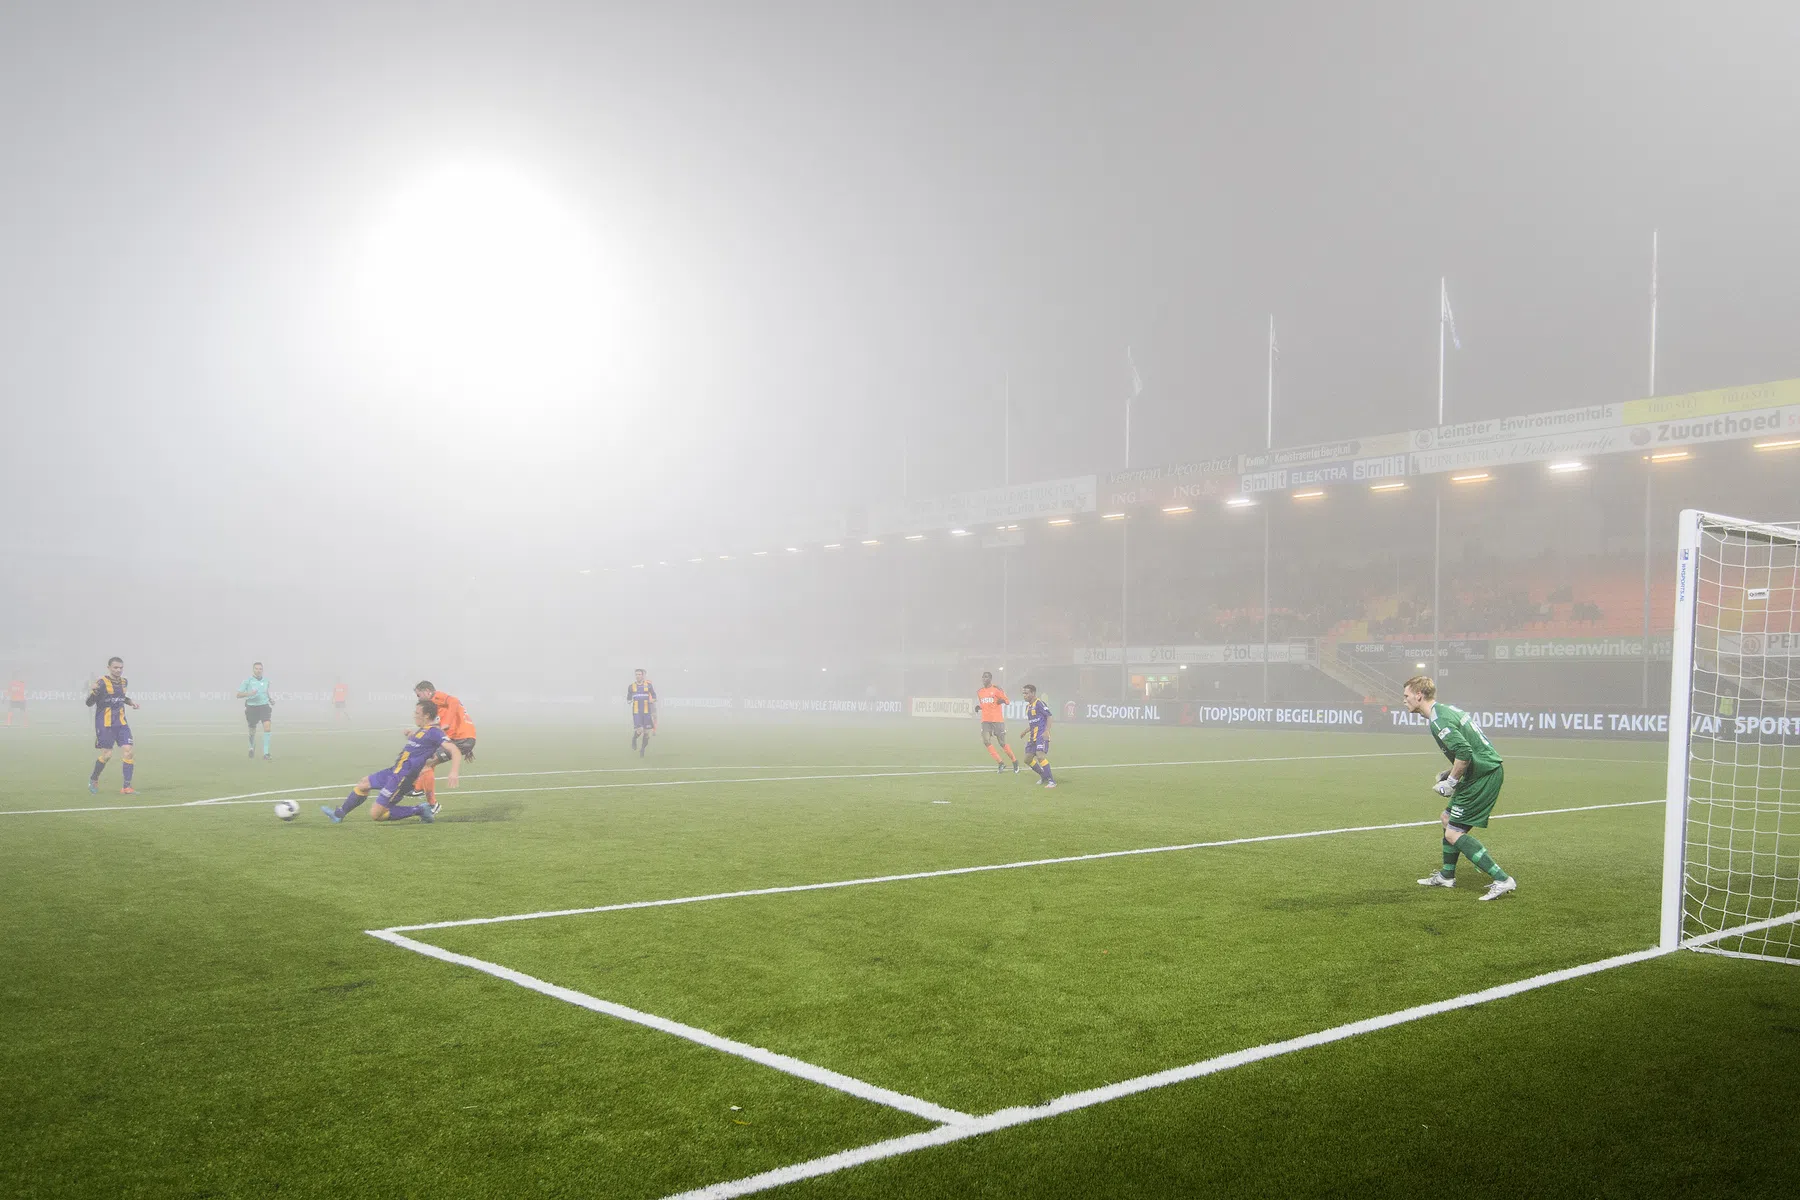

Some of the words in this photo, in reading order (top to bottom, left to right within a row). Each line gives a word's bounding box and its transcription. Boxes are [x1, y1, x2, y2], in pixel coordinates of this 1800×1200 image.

[1437, 421, 1492, 440] Leinster
[1500, 405, 1613, 432] Environmentals
[1657, 410, 1781, 442] Zwarthoed
[1291, 467, 1349, 485] ELEKTRA
[1112, 492, 1137, 505] ING
[1173, 485, 1201, 501] ING
[1233, 644, 1251, 660] tol
[1355, 644, 1384, 653] SCHENK
[1405, 649, 1448, 658] RECYCLNG
[1086, 704, 1160, 720] JSCSPORT.NL
[1199, 706, 1273, 724] (TOP)SPORT
[1276, 709, 1363, 725] BEGELEIDING
[1391, 711, 1430, 725] TALE
[1467, 711, 1534, 731] ADEMY;
[1539, 714, 1556, 729] IN
[1561, 714, 1604, 730] VELE
[1608, 715, 1668, 732] TAKKE
